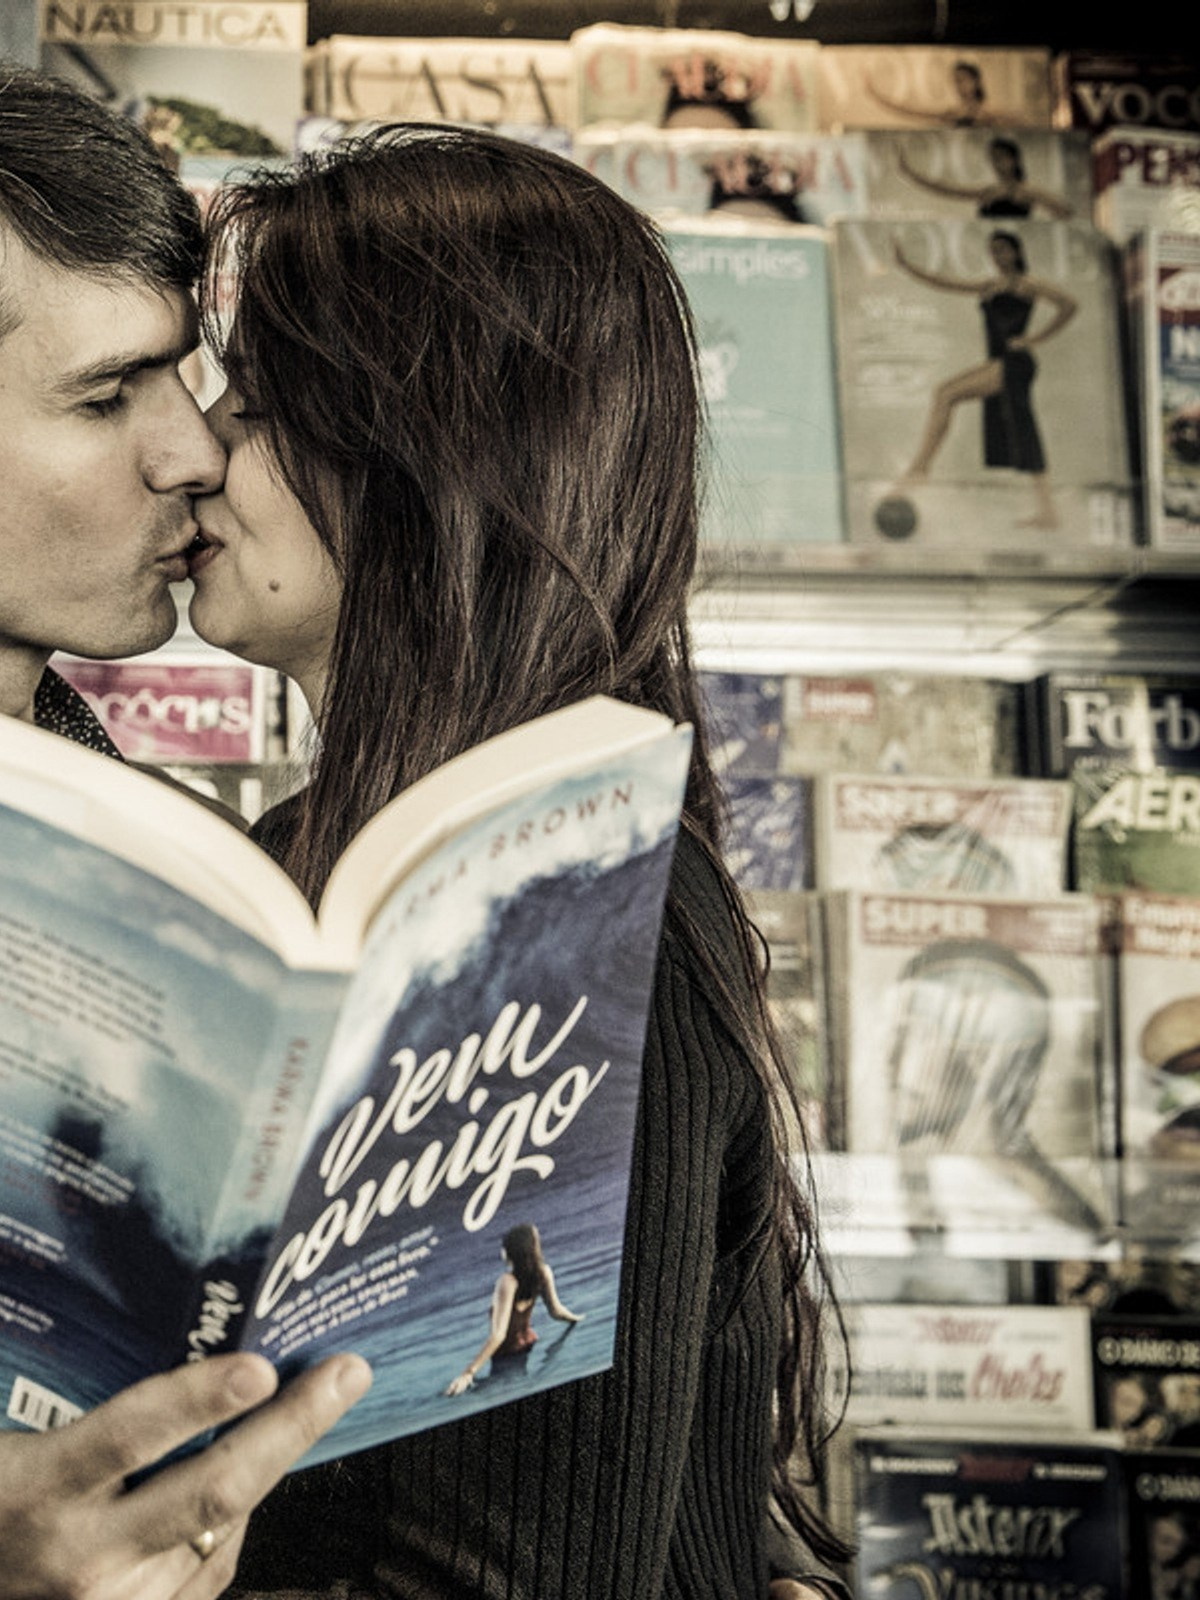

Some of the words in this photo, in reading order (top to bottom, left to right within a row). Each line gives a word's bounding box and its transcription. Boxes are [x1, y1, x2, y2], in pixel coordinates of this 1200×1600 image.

[488, 781, 632, 861] BROWN
[254, 1060, 610, 1320] comigo
[319, 995, 587, 1197] Vem
